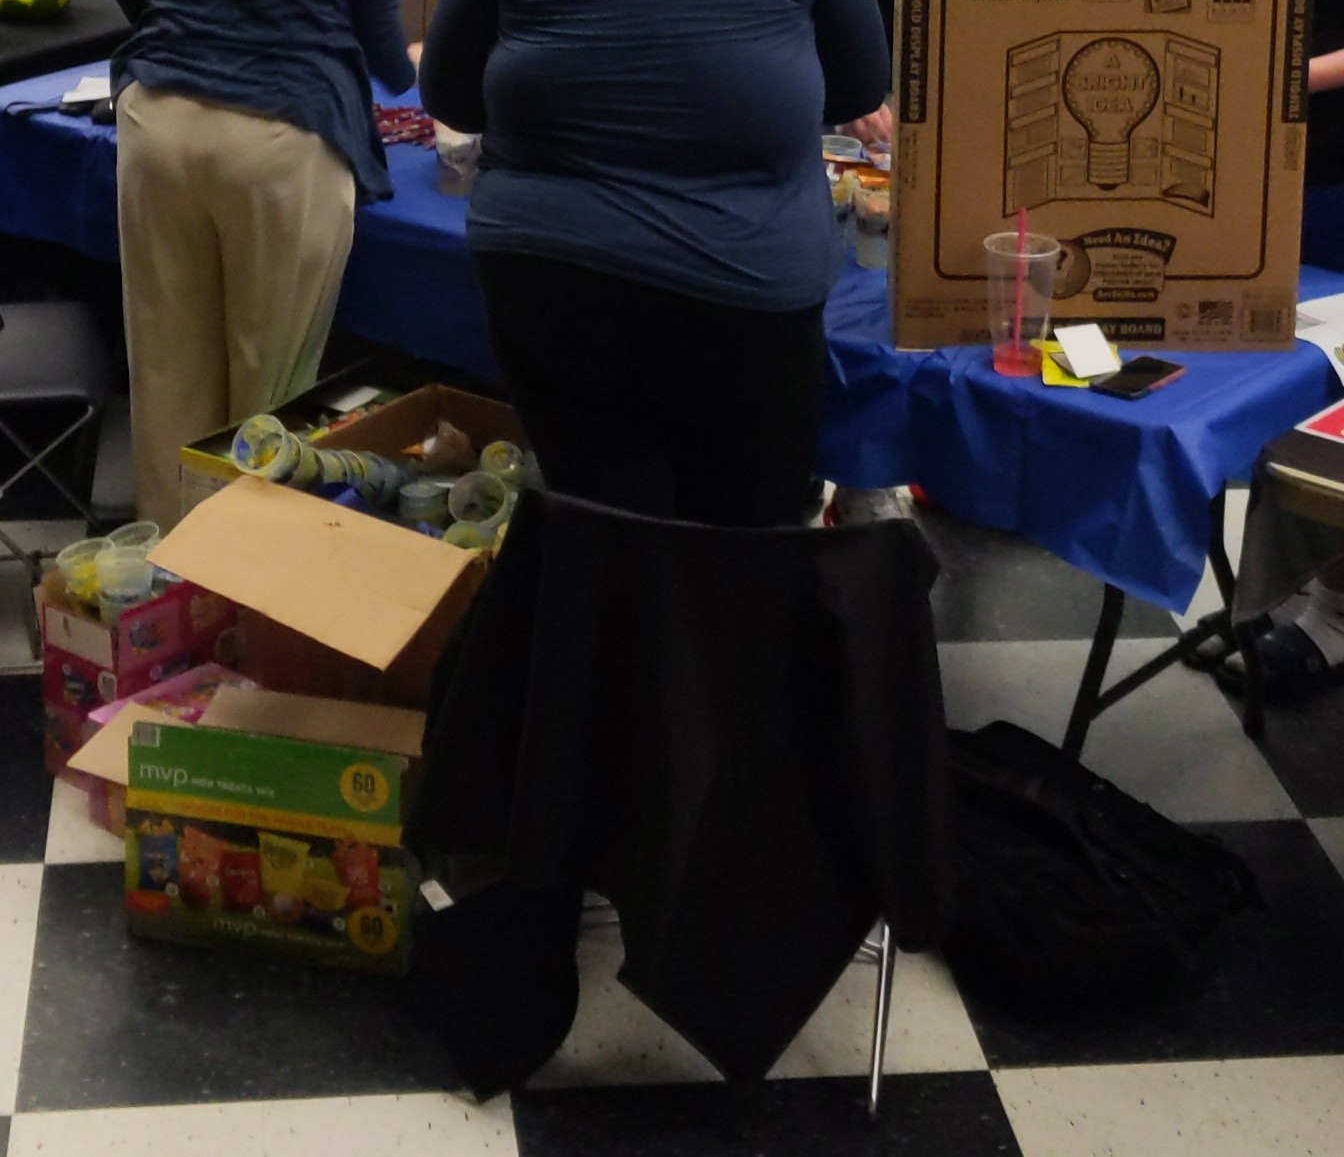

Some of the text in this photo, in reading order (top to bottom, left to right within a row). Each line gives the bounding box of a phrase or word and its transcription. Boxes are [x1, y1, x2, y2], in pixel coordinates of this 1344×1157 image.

[1119, 323, 1163, 335] BOARD
[139, 762, 189, 788] mvp
[351, 771, 377, 794] 60
[360, 915, 384, 937] 60
